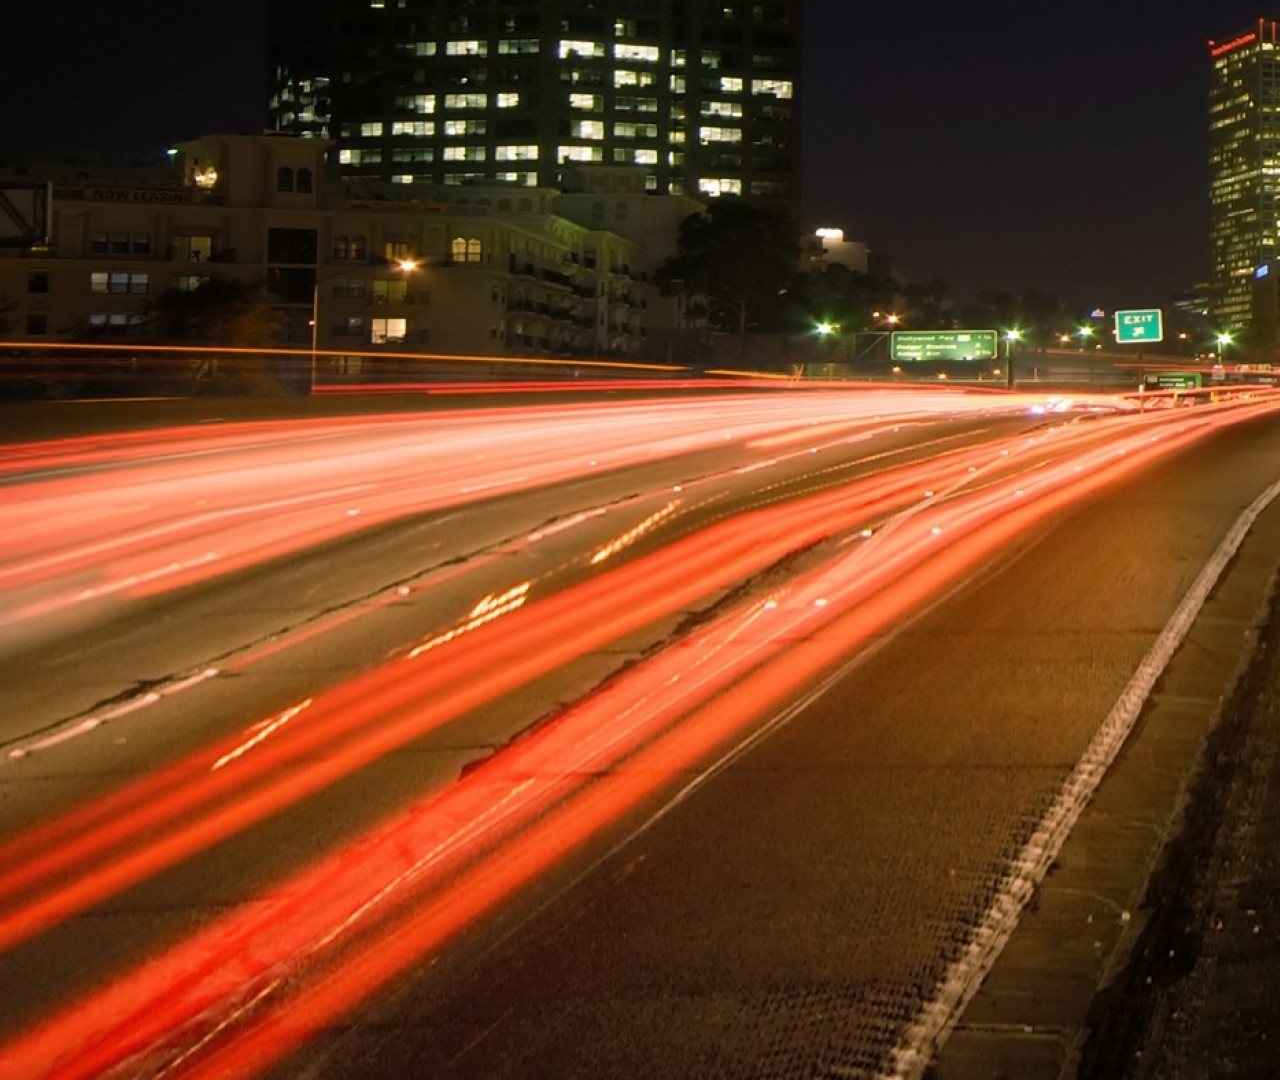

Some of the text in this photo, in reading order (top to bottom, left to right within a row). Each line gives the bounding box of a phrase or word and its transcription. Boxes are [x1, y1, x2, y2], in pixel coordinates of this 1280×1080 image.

[94, 189, 193, 202] NOW LEASING
[1124, 315, 1153, 324] EXIT
